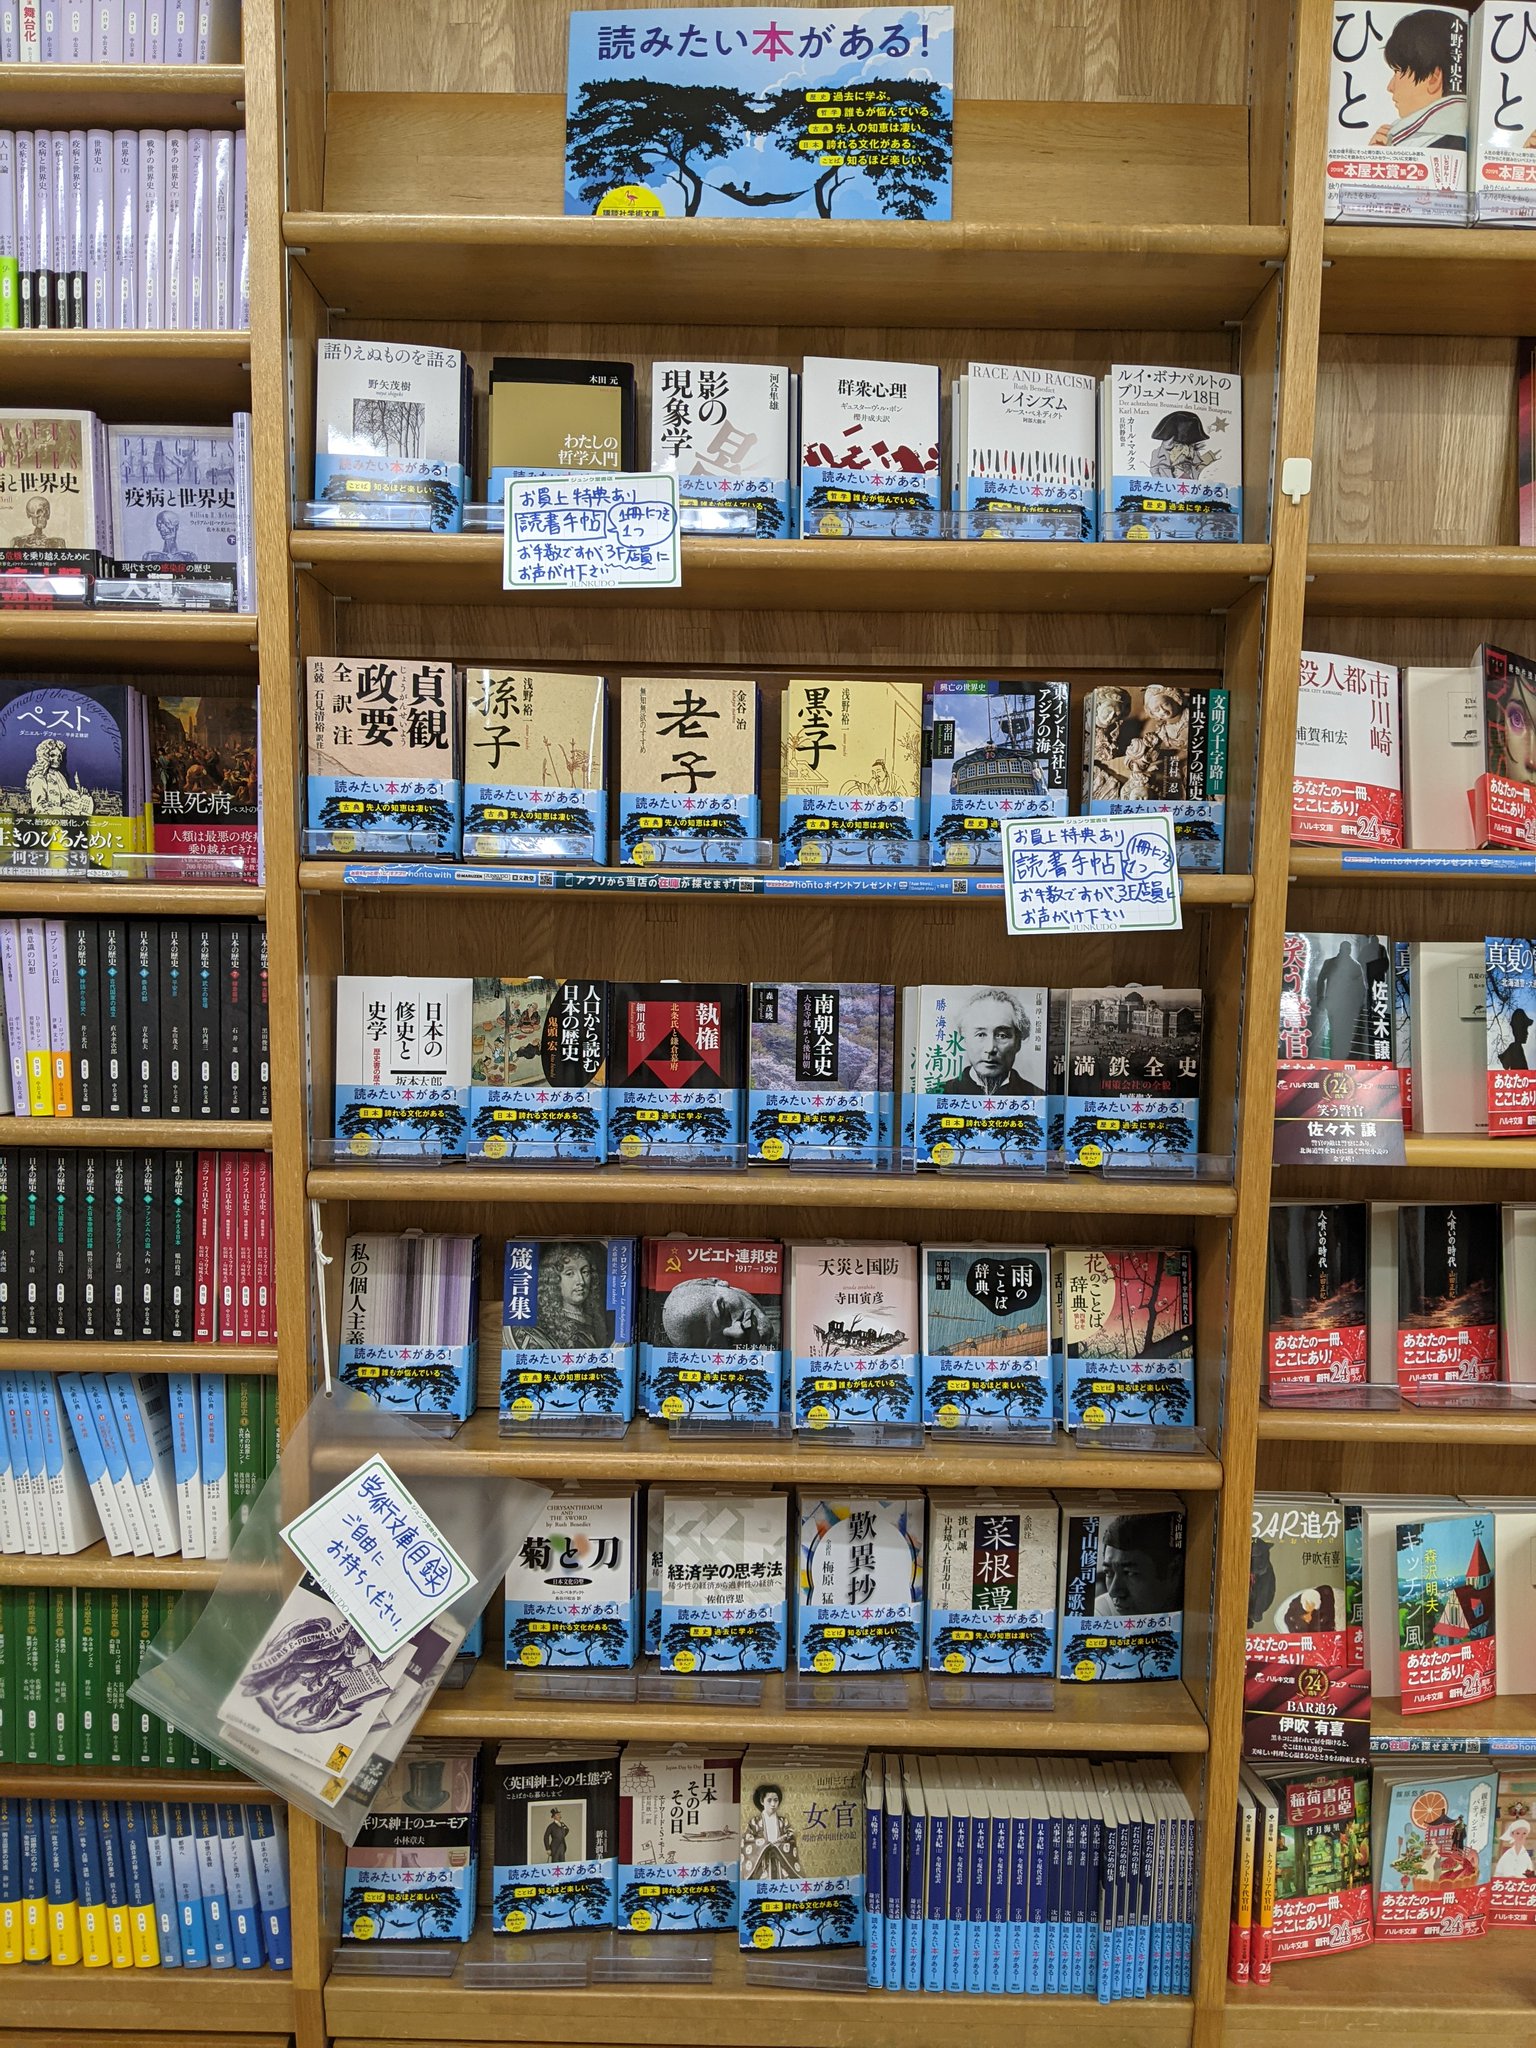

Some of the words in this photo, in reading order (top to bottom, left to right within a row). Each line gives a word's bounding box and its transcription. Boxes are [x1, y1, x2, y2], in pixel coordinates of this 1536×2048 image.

[23, 6, 36, 42] 舞台化
[1333, 10, 1383, 129] ひと
[1450, 19, 1464, 92] 小野寺史宣
[833, 90, 892, 102] 過去に学ぶ。
[845, 106, 936, 119] 誰もが悩んでいる。
[803, 141, 820, 149] 日本
[826, 138, 920, 151] 誇れる文化がある。
[812, 124, 830, 133] 古典
[836, 122, 929, 135] 先人の知恵は凄い。
[847, 154, 930, 167] 知るほど楽しい。
[323, 342, 457, 369] 語りえぬものを語る
[367, 378, 412, 391] 野矢茂樹
[768, 372, 780, 411] 河合隼雄
[837, 378, 908, 400] 群衆心理
[973, 364, 1007, 381] RACE
[1012, 368, 1042, 385] AND
[1046, 371, 1094, 391] RACISM
[1118, 368, 1232, 390] ルイ・ボナパルトの
[660, 368, 694, 456] 現象学
[696, 369, 730, 427] 影の
[1001, 391, 1068, 412] レイシズム
[1118, 384, 1221, 407] ブリュメール18日
[1119, 407, 1134, 415] Karl
[1135, 407, 1150, 415] Marx
[558, 449, 618, 467] 哲学入門
[564, 434, 618, 450] わたしの
[1126, 416, 1136, 471] カール・マルクス
[126, 488, 235, 508] 疫病と世界史
[830, 492, 849, 502] 哲学
[519, 511, 601, 535] 読書手帖
[518, 564, 609, 582] お声がけ下さい
[333, 662, 352, 746] 全訳注
[523, 678, 533, 722] 浅野裕一
[940, 682, 986, 692] 興亡の世界史
[17, 706, 91, 732] ペスト
[357, 664, 398, 746] 政要
[406, 666, 449, 748] 貞観
[473, 676, 520, 769] 孫子
[841, 688, 850, 730] 浅野裕一
[1036, 687, 1052, 754] アジアの海
[656, 689, 720, 793] 老子
[796, 687, 836, 770] 墨子
[1051, 686, 1067, 786] 東インド会社と
[1370, 700, 1393, 757] 川崎
[1189, 695, 1206, 800] 中央アジアの歴史
[161, 791, 231, 814] 黒死病
[342, 803, 361, 811] 古典
[1292, 780, 1371, 801] あなたの一冊、
[1015, 854, 1116, 880] 読書手帖
[1022, 907, 1125, 928] お声がけ下さい
[1071, 923, 1117, 931] JUNKUDO
[78, 930, 86, 966] 日本の歴史
[367, 1001, 388, 1041] 史学
[395, 1001, 417, 1060] 修史と
[422, 1002, 444, 1057] 日本の
[561, 985, 579, 1062] 日本の歴史
[582, 985, 601, 1072] 人口から読む
[636, 1003, 646, 1041] 細川重男
[670, 1003, 679, 1071] 北条氏と鎌倉幕府
[696, 1003, 719, 1050] 執権
[813, 994, 834, 1077] 南朝全史
[945, 1031, 965, 1082] 氷川
[1074, 1055, 1197, 1078] 満鉄全史
[395, 1076, 442, 1086] 坂本太郎
[29, 1158, 37, 1193] 日本の歴史
[687, 1248, 778, 1264] ソビエト連邦史
[1318, 1210, 1328, 1268] 人喰いの時代
[1447, 1210, 1457, 1268] 人喰いの時代
[509, 1248, 532, 1320] 箴言集
[818, 1259, 899, 1276] 天災と国防
[974, 1264, 990, 1296] 辞典
[1011, 1264, 1034, 1300] 雨の
[346, 1243, 370, 1344] 私の個人主義
[834, 1292, 883, 1305] 寺田寅彦
[995, 1265, 1007, 1310] ことば
[1070, 1276, 1089, 1312] 辞典
[1275, 1332, 1343, 1350] あなたの一冊、
[341, 1512, 384, 1565] ご自由に
[519, 1537, 620, 1570] 菊と刀
[1079, 1517, 1100, 1584] 寺山修司
[668, 1562, 783, 1581] 経済学の思考法
[848, 1511, 877, 1605] 歎異抄
[1302, 1551, 1340, 1566] 伊吹有喜
[319, 1576, 349, 1614] JUNKUDO
[1424, 1548, 1440, 1613] 森沢明夫
[1287, 1700, 1338, 1714] BAR追分
[687, 1781, 700, 1825] その日
[701, 1773, 717, 1805] 日本
[1290, 1786, 1351, 1807] 稲荷書店
[670, 1790, 684, 1834] その日
[803, 1800, 857, 1830] 女官
[1290, 1800, 1353, 1822] きつね堂
[393, 1837, 425, 1845] 小林章夫
